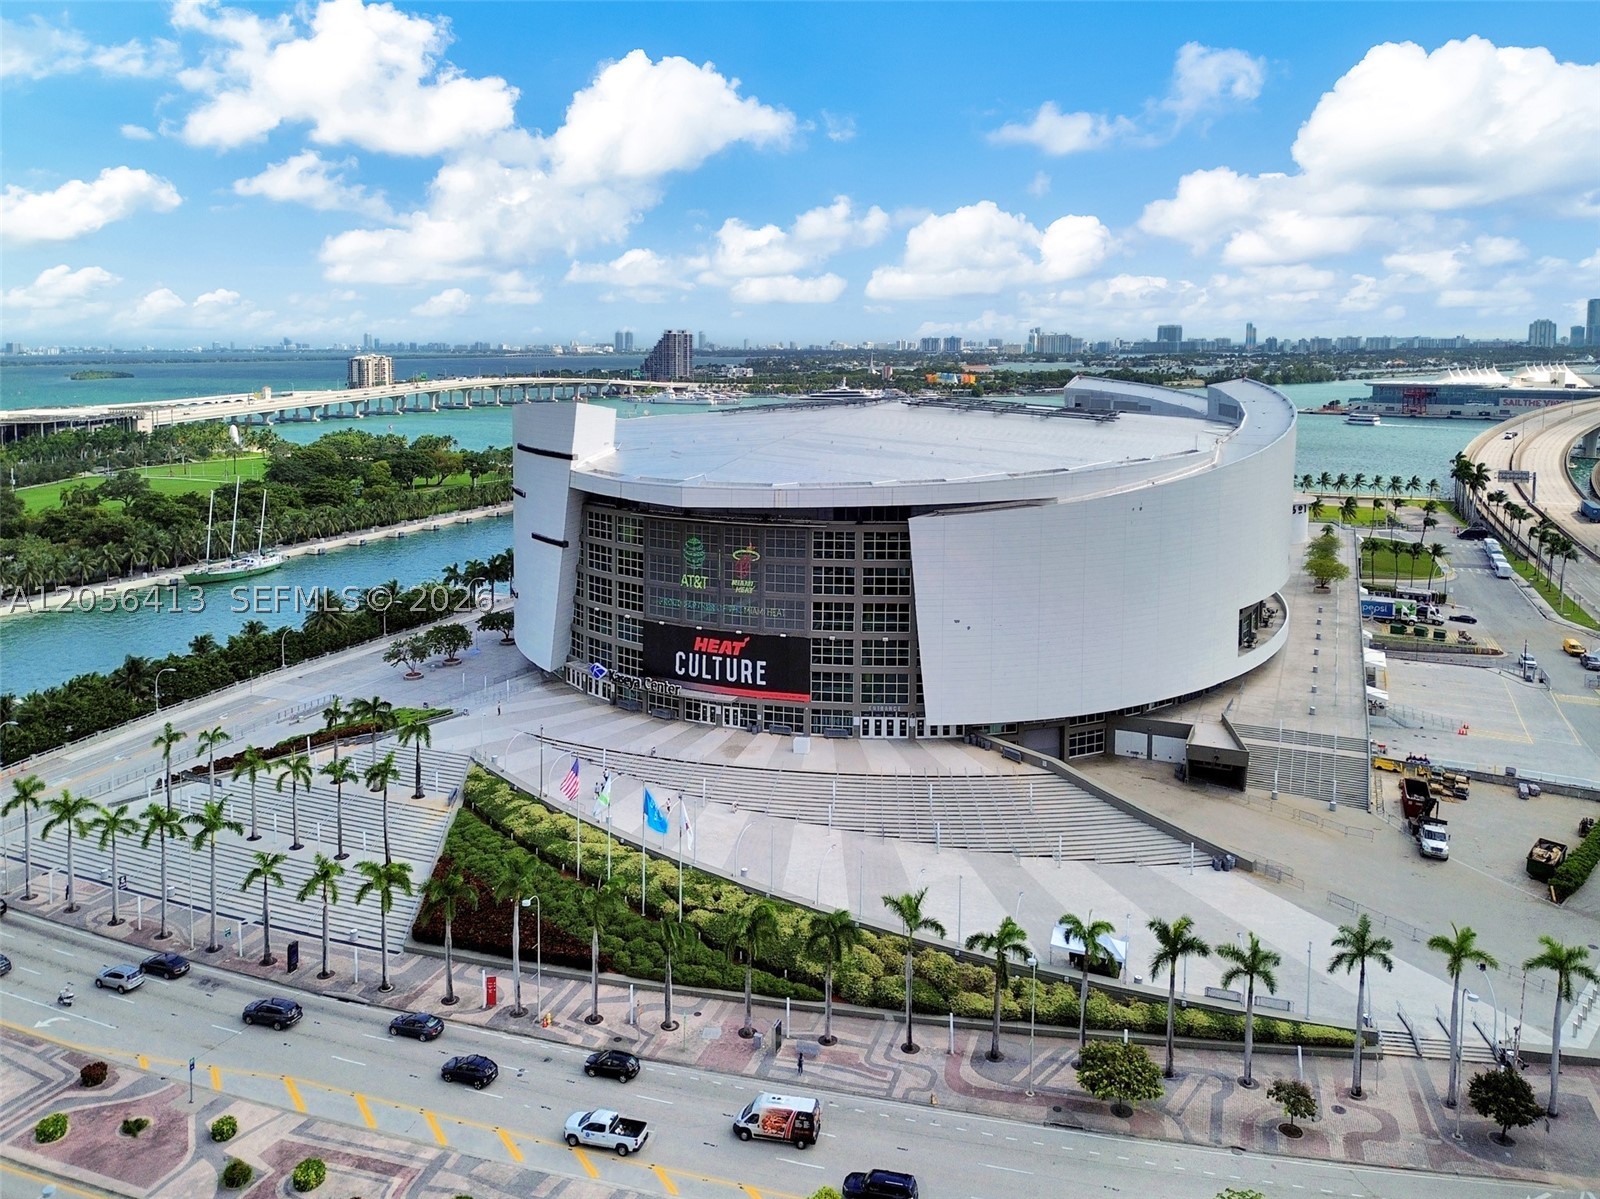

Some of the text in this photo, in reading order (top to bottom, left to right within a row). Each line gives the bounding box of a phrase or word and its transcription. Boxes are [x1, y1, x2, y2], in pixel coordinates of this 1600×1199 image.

[1503, 399, 1522, 407] SAIL
[1522, 399, 1541, 407] THE
[681, 574, 709, 589] AT&T
[735, 586, 756, 594] HEAT
[743, 606, 765, 616] MIAMI
[766, 608, 786, 617] HEAT
[1362, 605, 1387, 613] pepsi
[694, 637, 750, 655] HEAT
[675, 651, 767, 685] CULTURE
[608, 669, 682, 695] Kaseya Center
